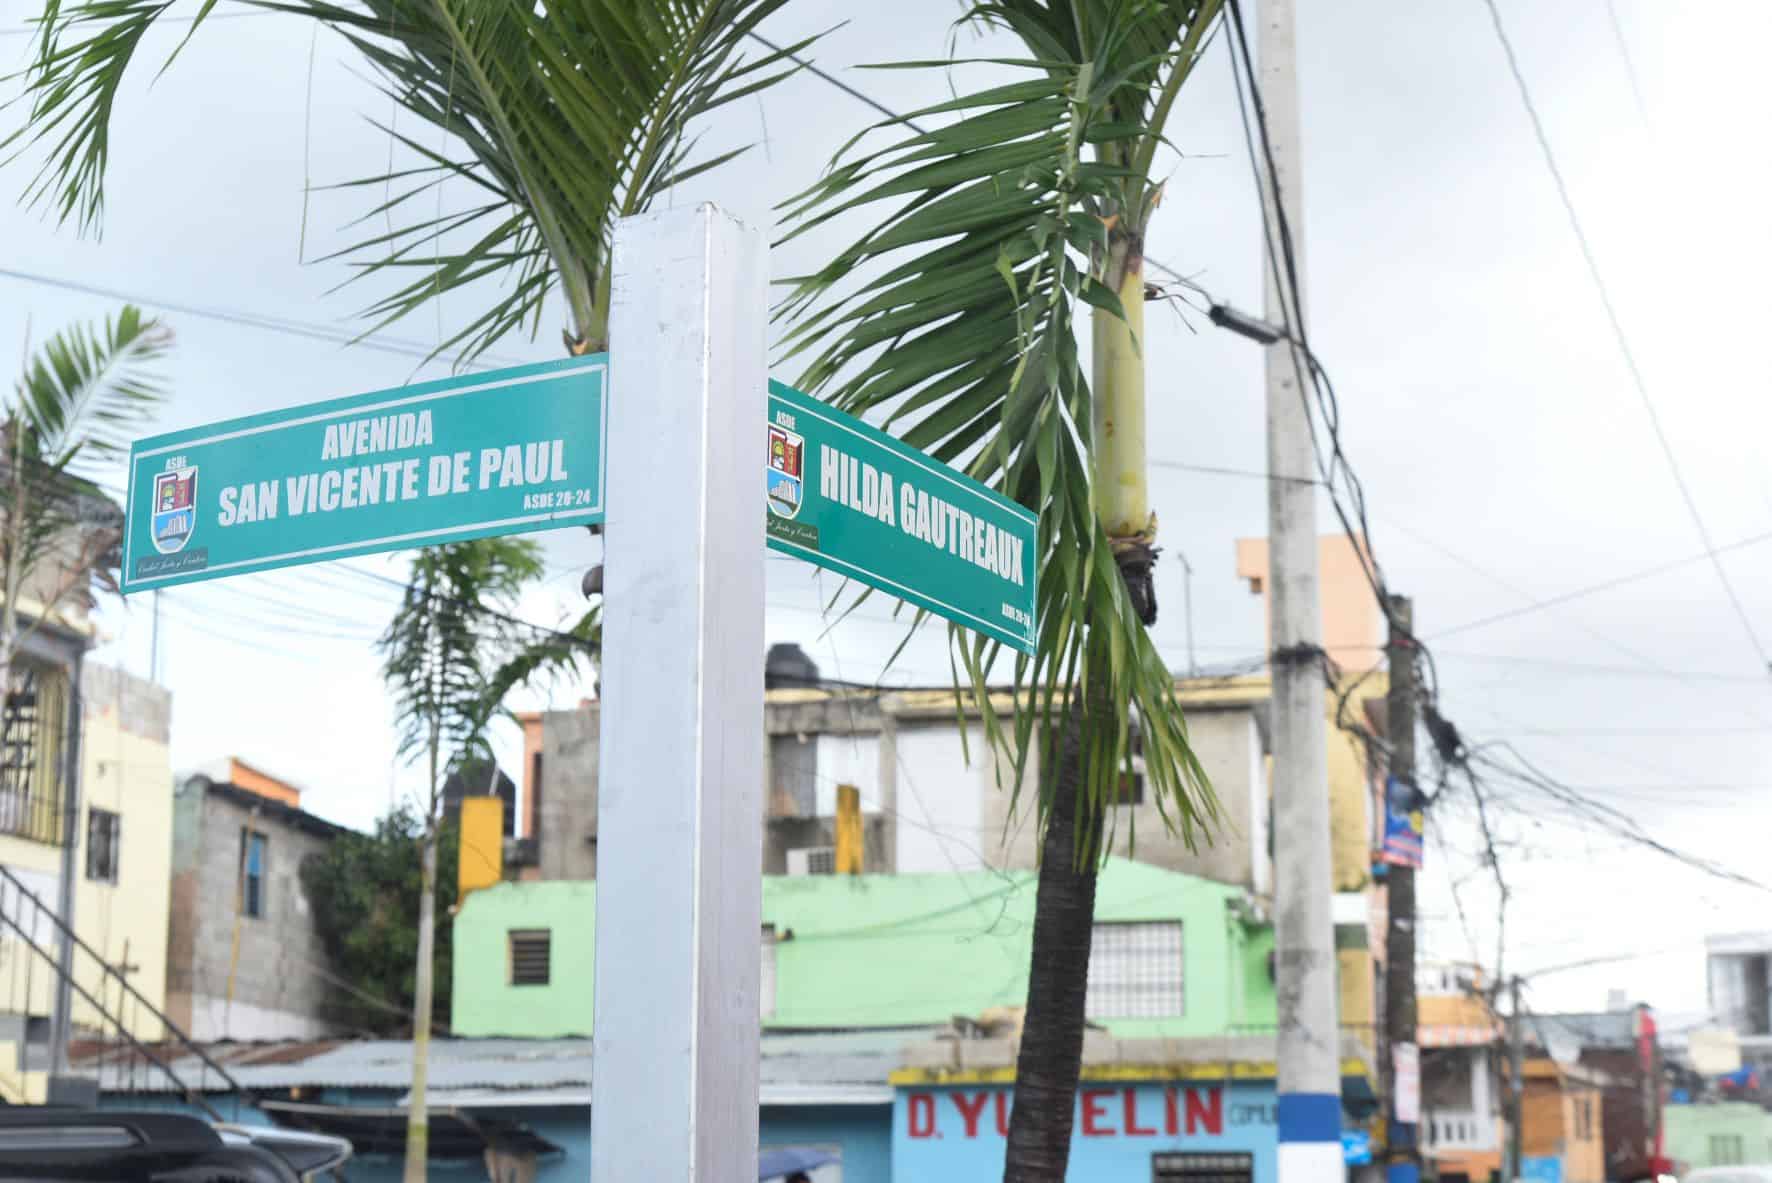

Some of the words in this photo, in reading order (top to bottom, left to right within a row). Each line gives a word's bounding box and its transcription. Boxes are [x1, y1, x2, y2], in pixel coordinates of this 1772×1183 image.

[321, 408, 434, 461] AVENIDA
[217, 479, 280, 528] SAN
[286, 458, 419, 516] VICENTE
[427, 451, 472, 497] DE
[478, 439, 568, 491] PAUL
[523, 492, 554, 511] ASDE
[820, 443, 897, 527] HILDA
[900, 482, 1025, 587] GAUTREAUX
